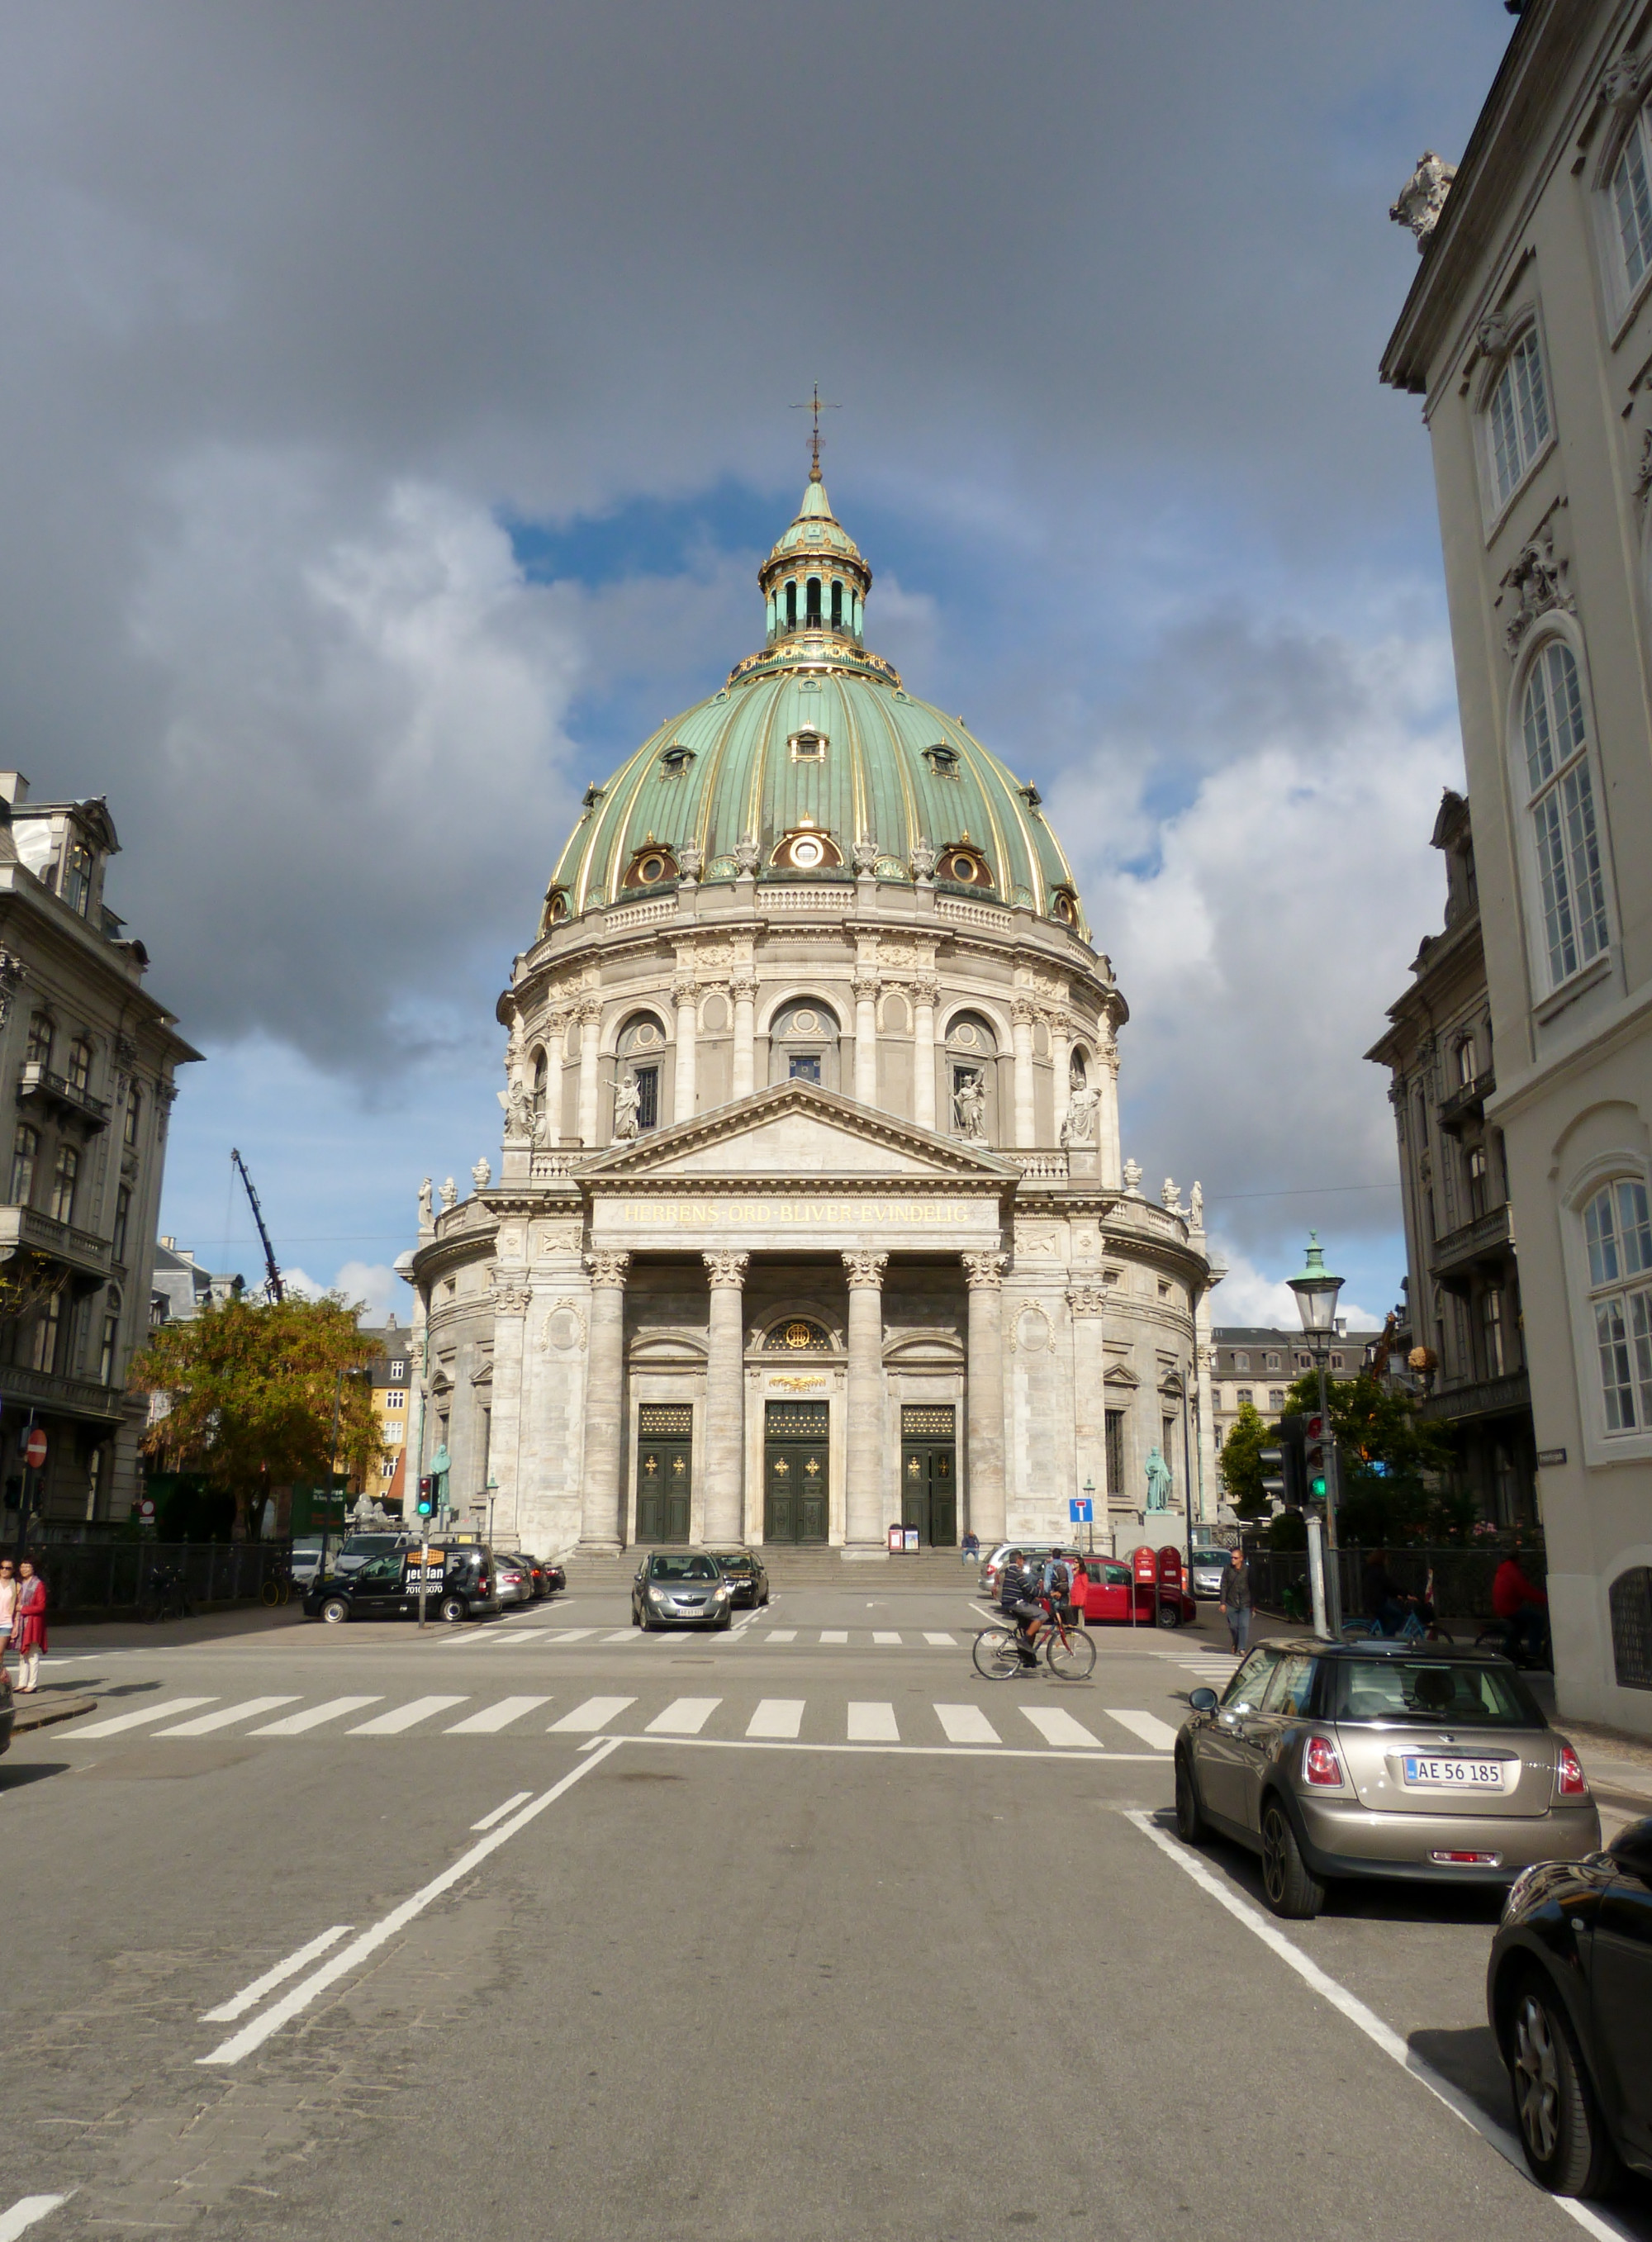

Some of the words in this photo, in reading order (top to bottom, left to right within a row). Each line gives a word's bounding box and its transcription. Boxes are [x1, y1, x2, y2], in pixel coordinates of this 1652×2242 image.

[1419, 1761, 1440, 1779] AE
[1445, 1763, 1464, 1780] 56
[1470, 1765, 1499, 1782] 185
